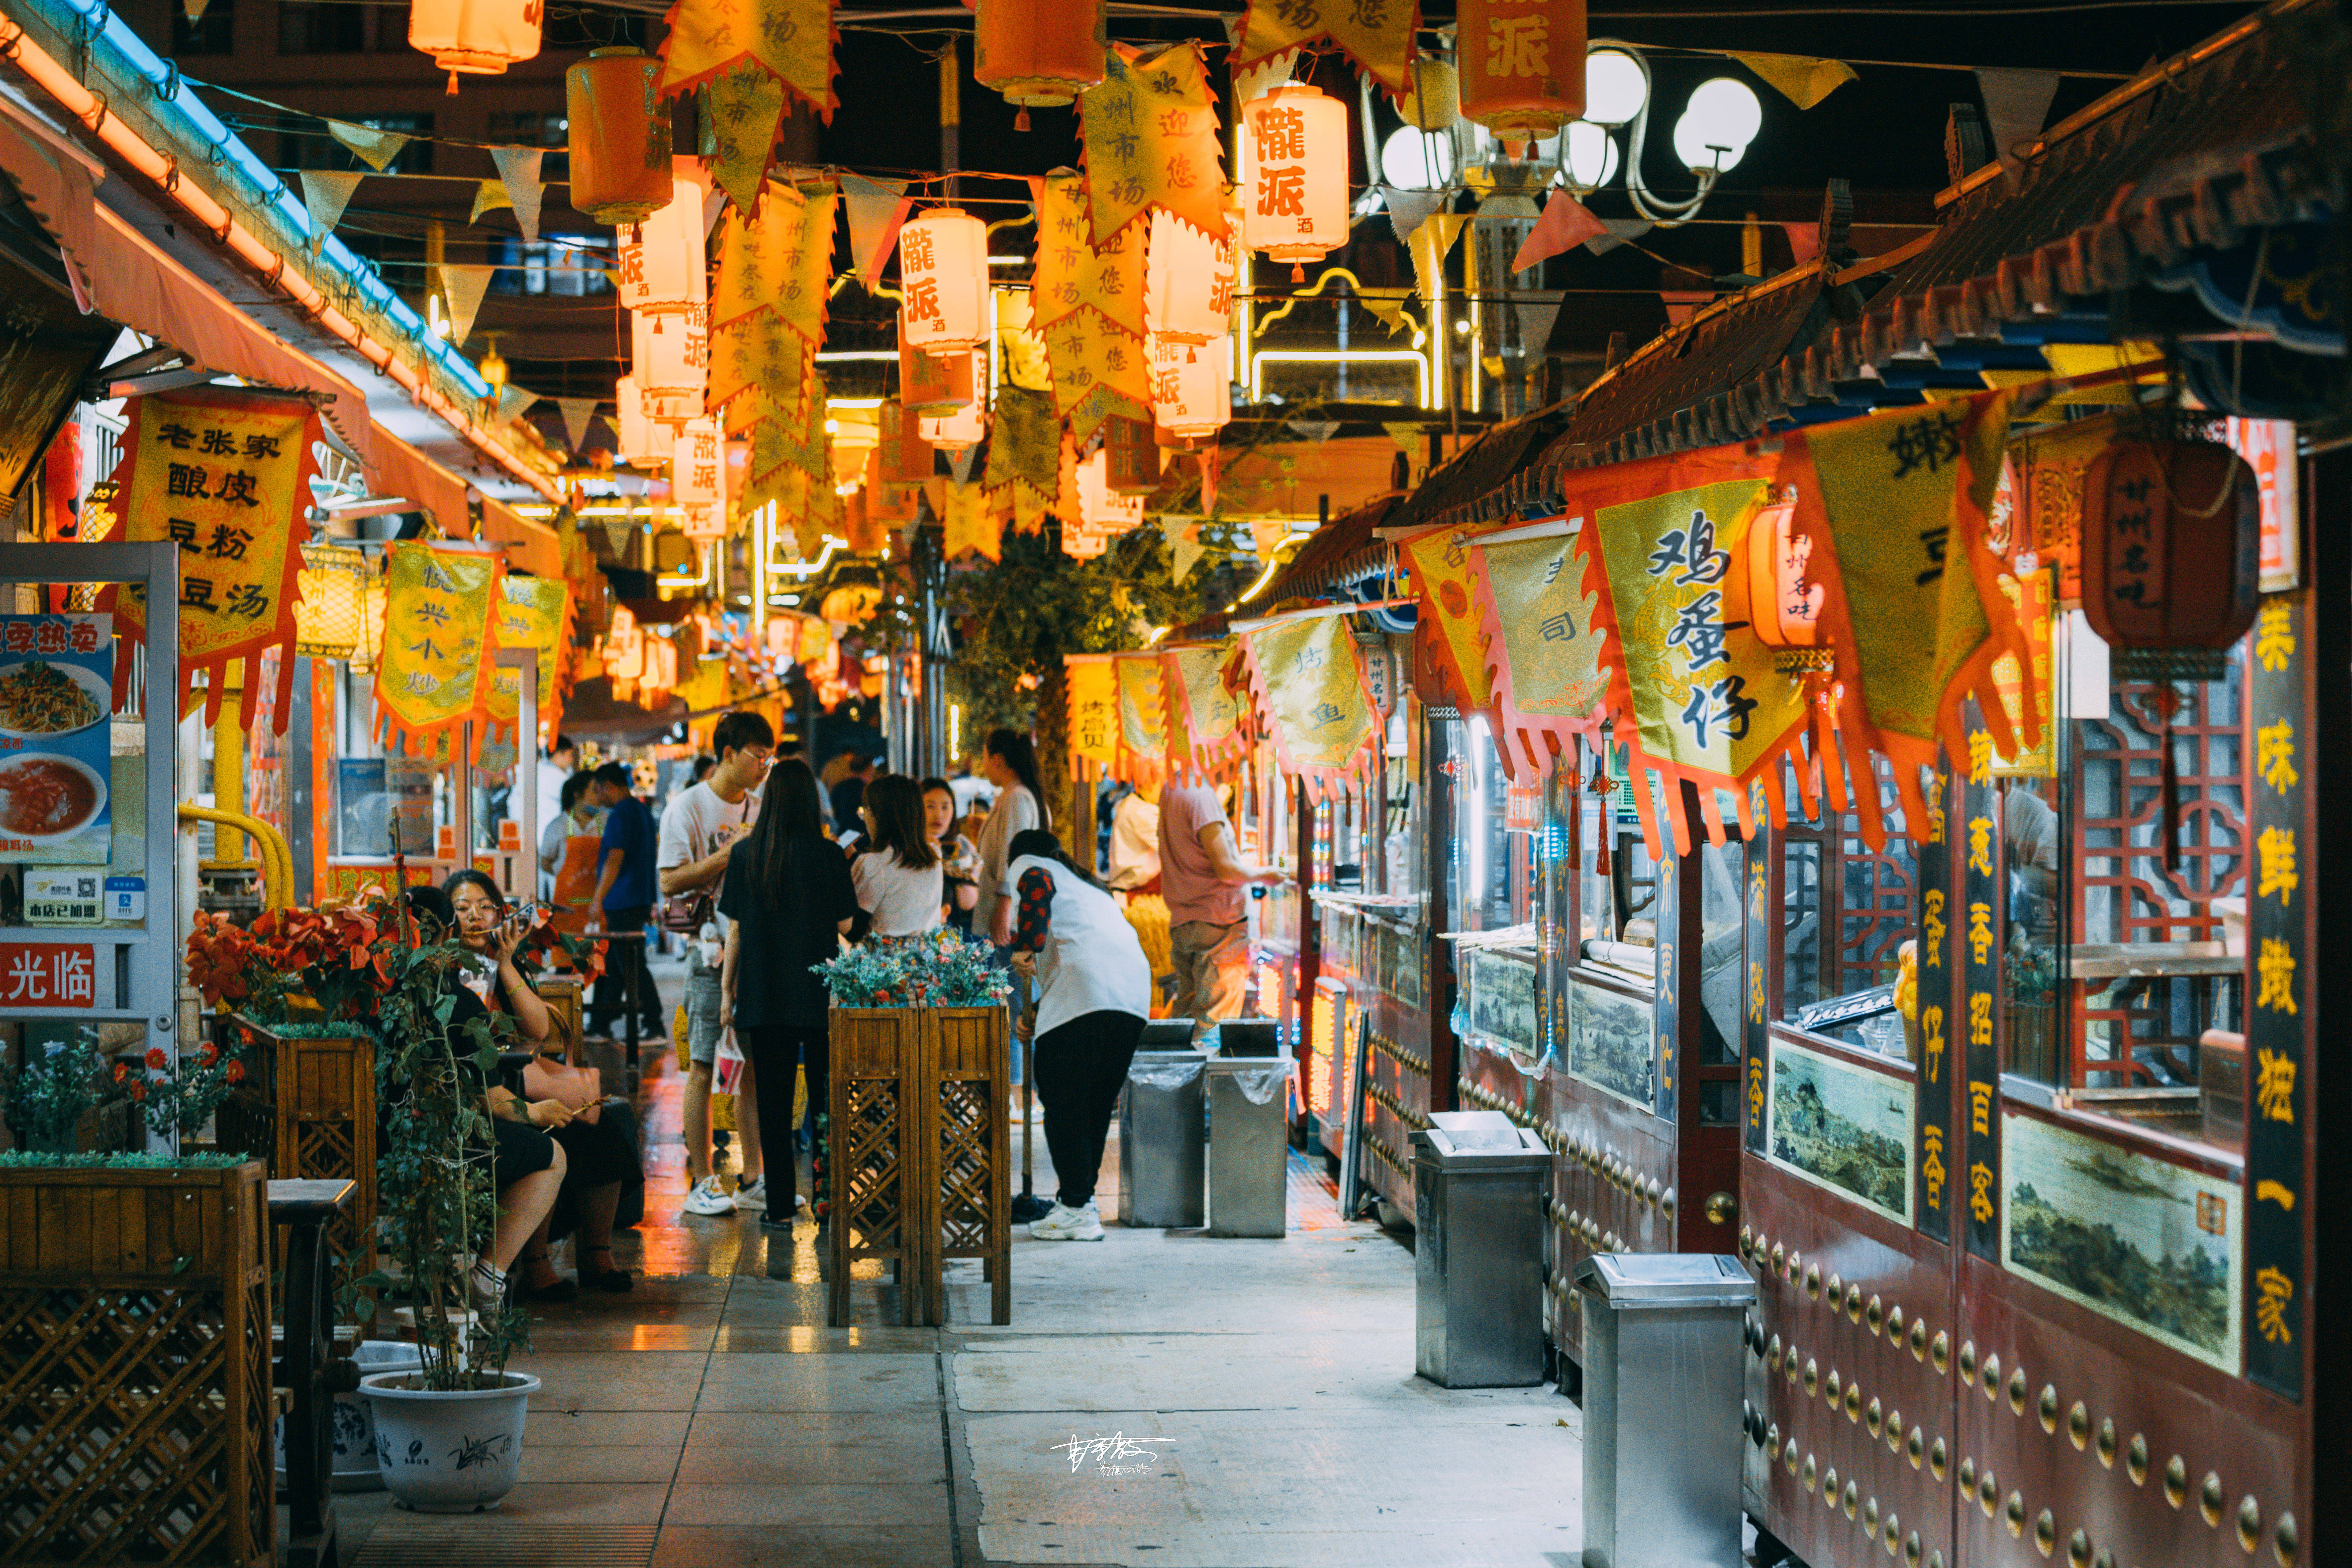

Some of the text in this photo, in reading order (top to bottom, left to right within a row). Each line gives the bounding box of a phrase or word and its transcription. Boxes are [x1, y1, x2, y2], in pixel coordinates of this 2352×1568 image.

[1152, 70, 1198, 189] 欢迎您
[157, 423, 281, 460] 老张家
[167, 462, 259, 507] 酿皮
[167, 518, 254, 560] 豆粉
[0, 622, 98, 654] 季热卖
[403, 564, 456, 696] 悦兴小炒
[495, 586, 535, 695] 悦兴炒
[1647, 510, 1759, 749] 鸡蛋仔
[1296, 646, 1346, 730] 烤鱼
[30, 904, 96, 918] 本店已加盟
[0, 950, 92, 1000] 光临
[2255, 597, 2300, 1345] 美味鲜嫩独一家
